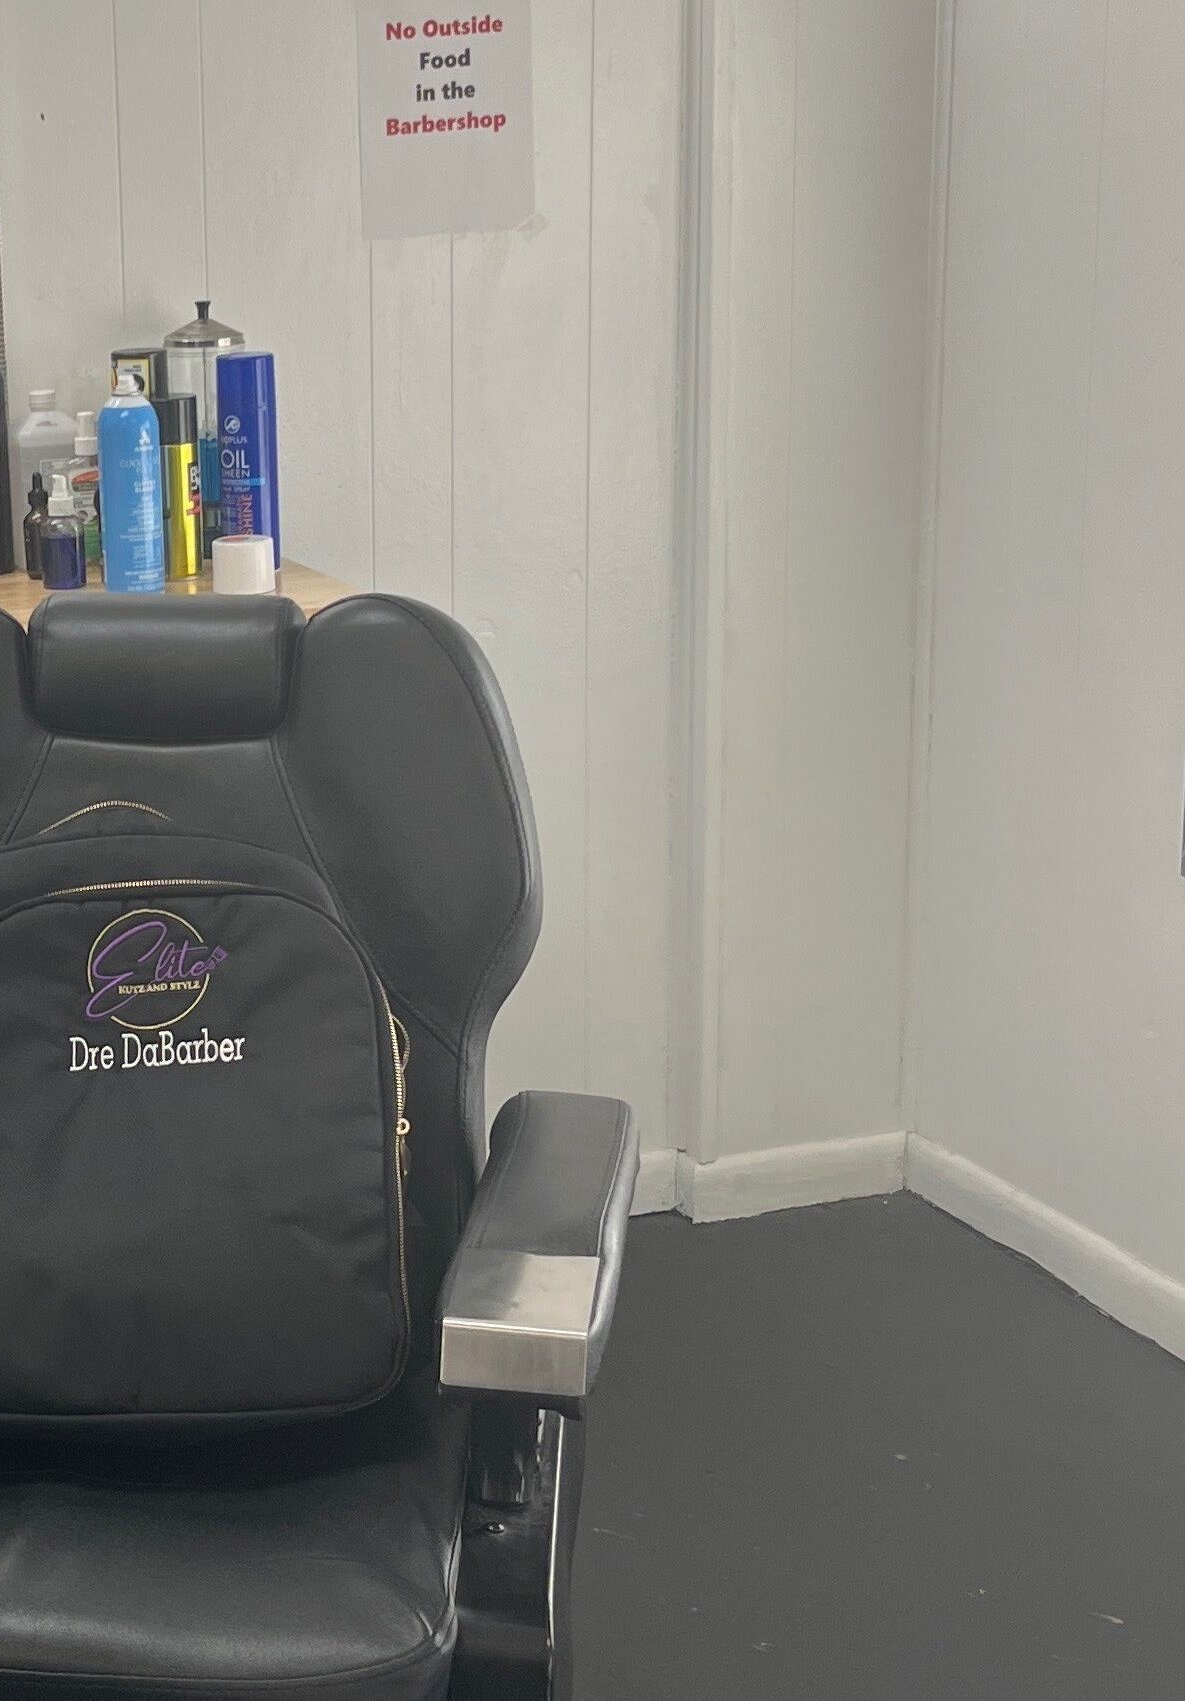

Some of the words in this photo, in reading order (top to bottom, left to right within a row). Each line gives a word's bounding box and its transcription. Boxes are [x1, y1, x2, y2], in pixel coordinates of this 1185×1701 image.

[385, 22, 417, 41] No
[422, 15, 504, 38] Outside
[419, 48, 471, 70] Food
[416, 84, 436, 102] in
[441, 81, 476, 100] the
[386, 111, 507, 137] Barbershop
[220, 449, 250, 469] OIL
[117, 984, 146, 995] KUTZ
[146, 982, 168, 993] AND
[69, 1036, 115, 1072] Dre
[121, 1028, 246, 1069] DaBarber
